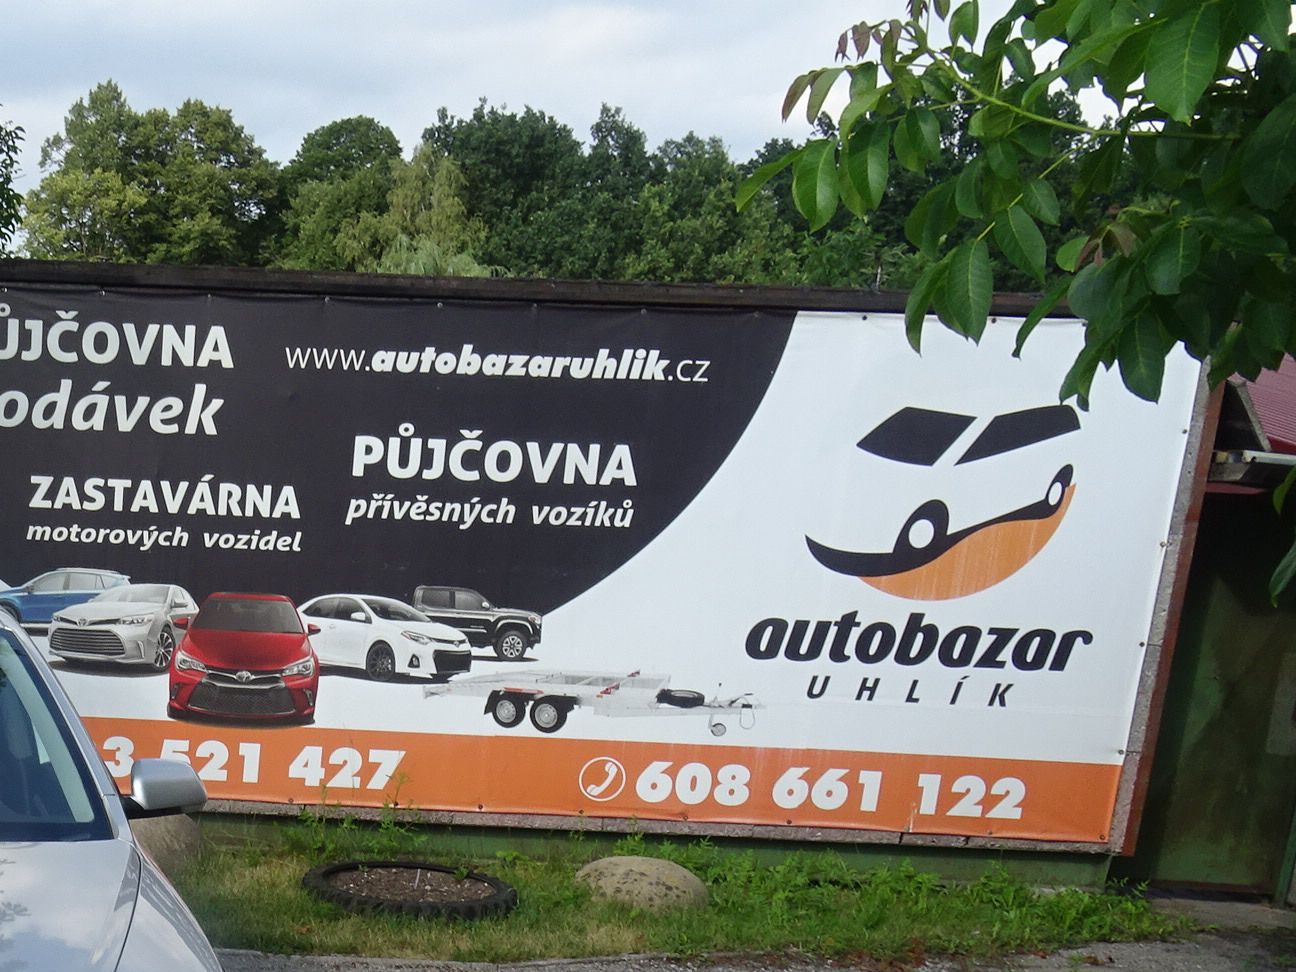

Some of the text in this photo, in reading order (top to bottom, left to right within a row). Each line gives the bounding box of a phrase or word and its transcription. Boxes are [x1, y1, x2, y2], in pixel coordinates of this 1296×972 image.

[285, 344, 711, 383] www.autobazaruhlik.cz
[351, 422, 638, 487] PŮJČOVNA
[29, 475, 301, 520] ZASTAVÁRNA
[344, 492, 635, 530] přívěsných vozíků
[26, 523, 302, 553] motorových vozidel
[744, 610, 1094, 672] autobazar
[805, 675, 1014, 708] UHLÍK
[287, 745, 407, 791] 427
[635, 760, 1027, 820] 608 661 122
